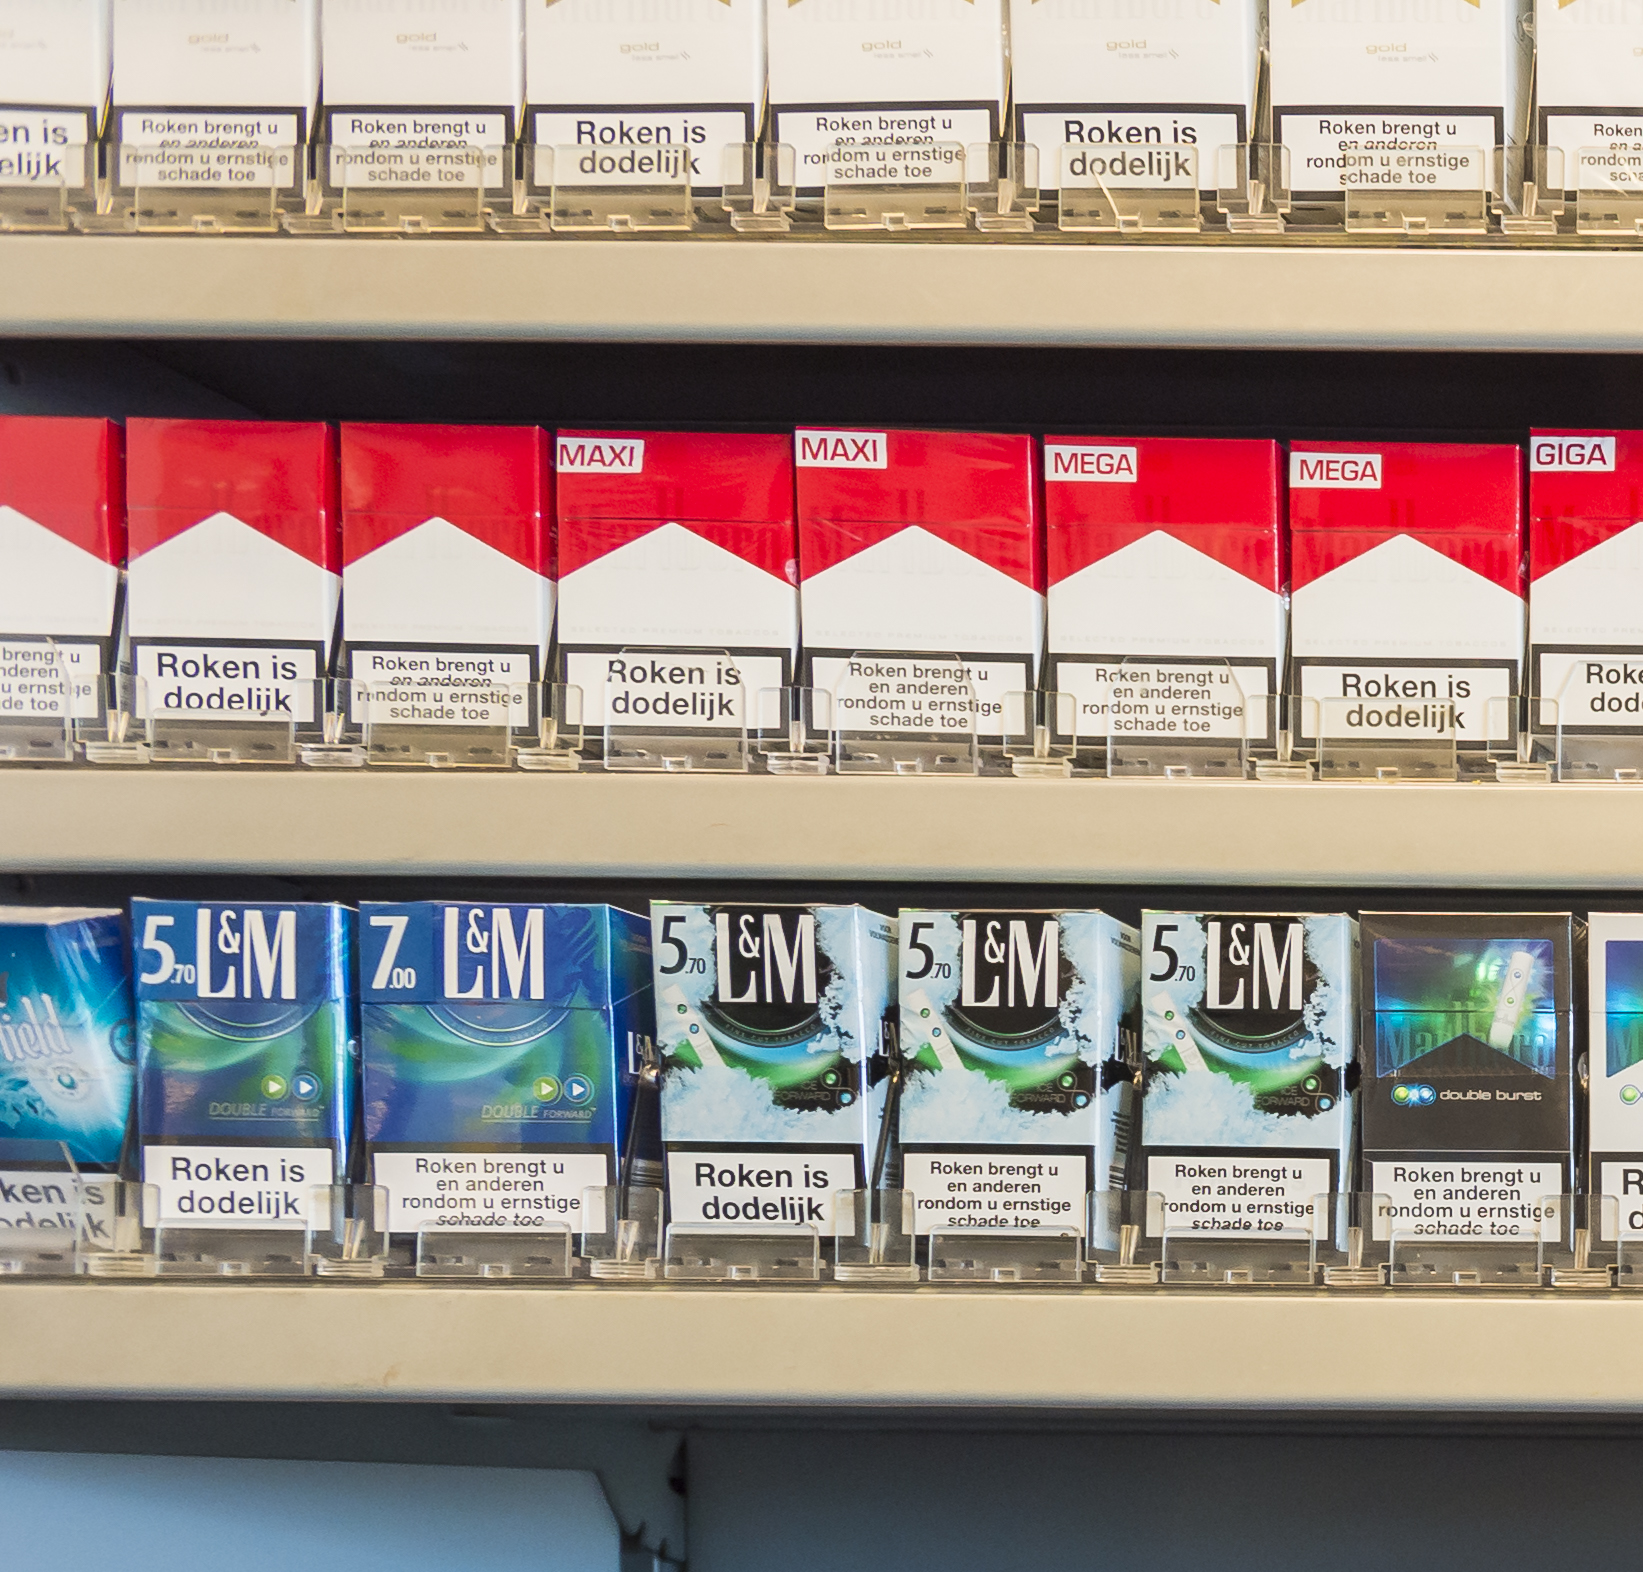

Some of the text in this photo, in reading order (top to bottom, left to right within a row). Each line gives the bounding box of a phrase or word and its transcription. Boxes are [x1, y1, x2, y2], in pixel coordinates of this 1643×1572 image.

[576, 120, 707, 146] Roken is
[579, 149, 701, 177] dodelijk
[559, 444, 635, 468] MAXI
[1054, 452, 1133, 475] MEGA
[1535, 443, 1607, 466] GIGA
[197, 907, 296, 999] L&M
[716, 914, 816, 1003] L&M
[1440, 1090, 1541, 1100] double burst
